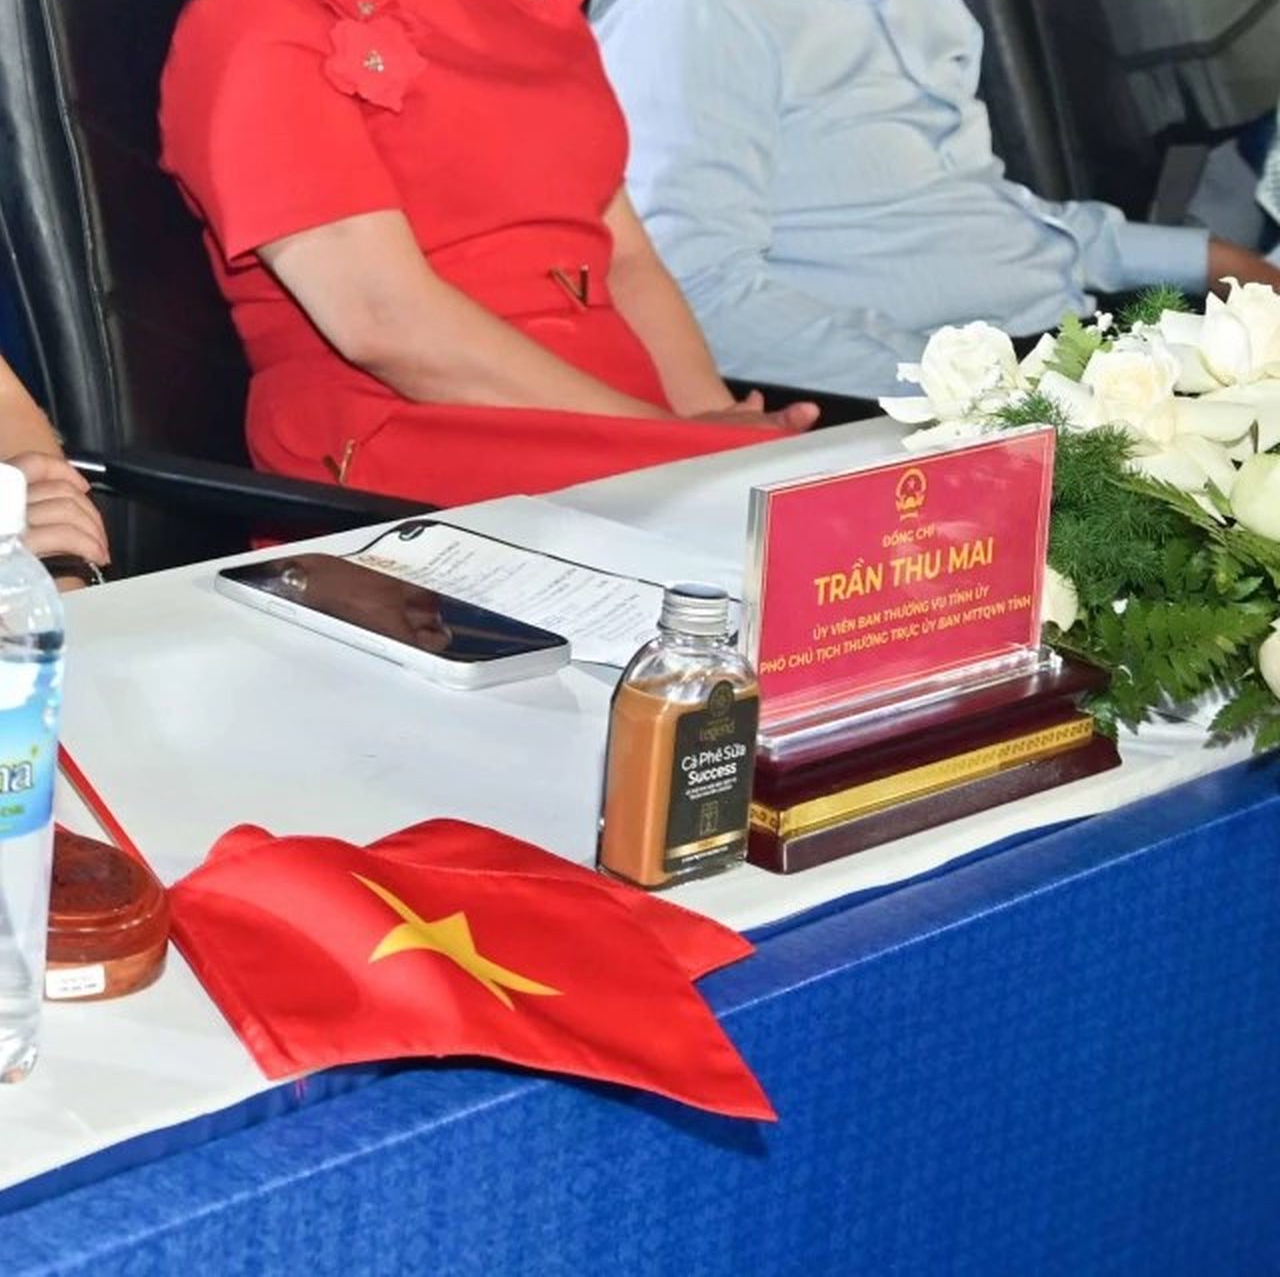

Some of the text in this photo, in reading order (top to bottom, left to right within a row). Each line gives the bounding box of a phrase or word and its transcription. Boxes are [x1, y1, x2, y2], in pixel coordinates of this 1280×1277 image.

[882, 524, 936, 548] ĐỒNG CHÍ
[814, 536, 994, 606] TRẦN THU MAI
[830, 615, 856, 637] VIÊN
[857, 610, 881, 629] BAN
[882, 599, 930, 624] THƯỜNG
[760, 657, 786, 676] PHÓ
[815, 641, 841, 662] TỊCH
[842, 630, 890, 655] THƯỜNG
[890, 624, 920, 644] TRỰC
[938, 611, 961, 630] BAN
[681, 756, 697, 772] Cà
[699, 748, 723, 767] Phê
[688, 762, 737, 786] Success
